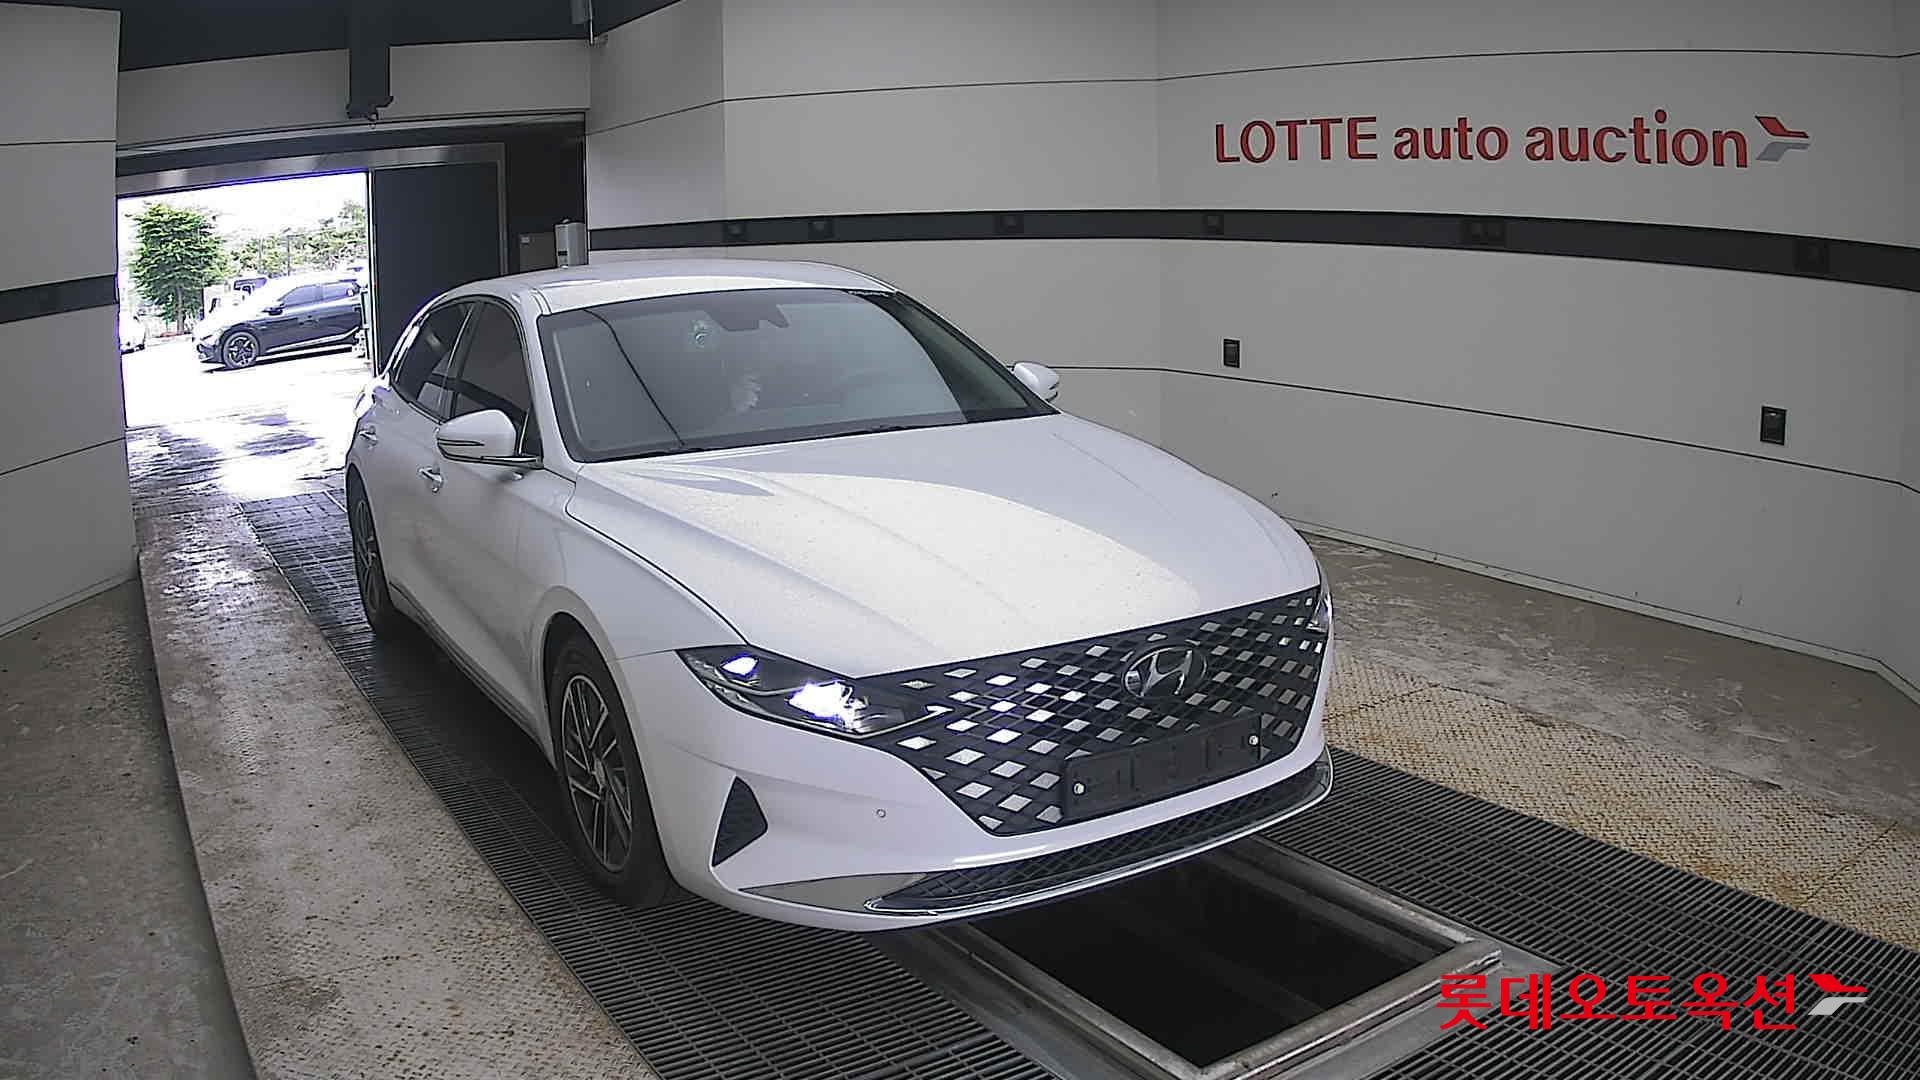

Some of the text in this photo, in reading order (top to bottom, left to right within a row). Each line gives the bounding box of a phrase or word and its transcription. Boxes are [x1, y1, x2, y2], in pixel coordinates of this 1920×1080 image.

[1215, 109, 1749, 169] LOTTE auto auction
